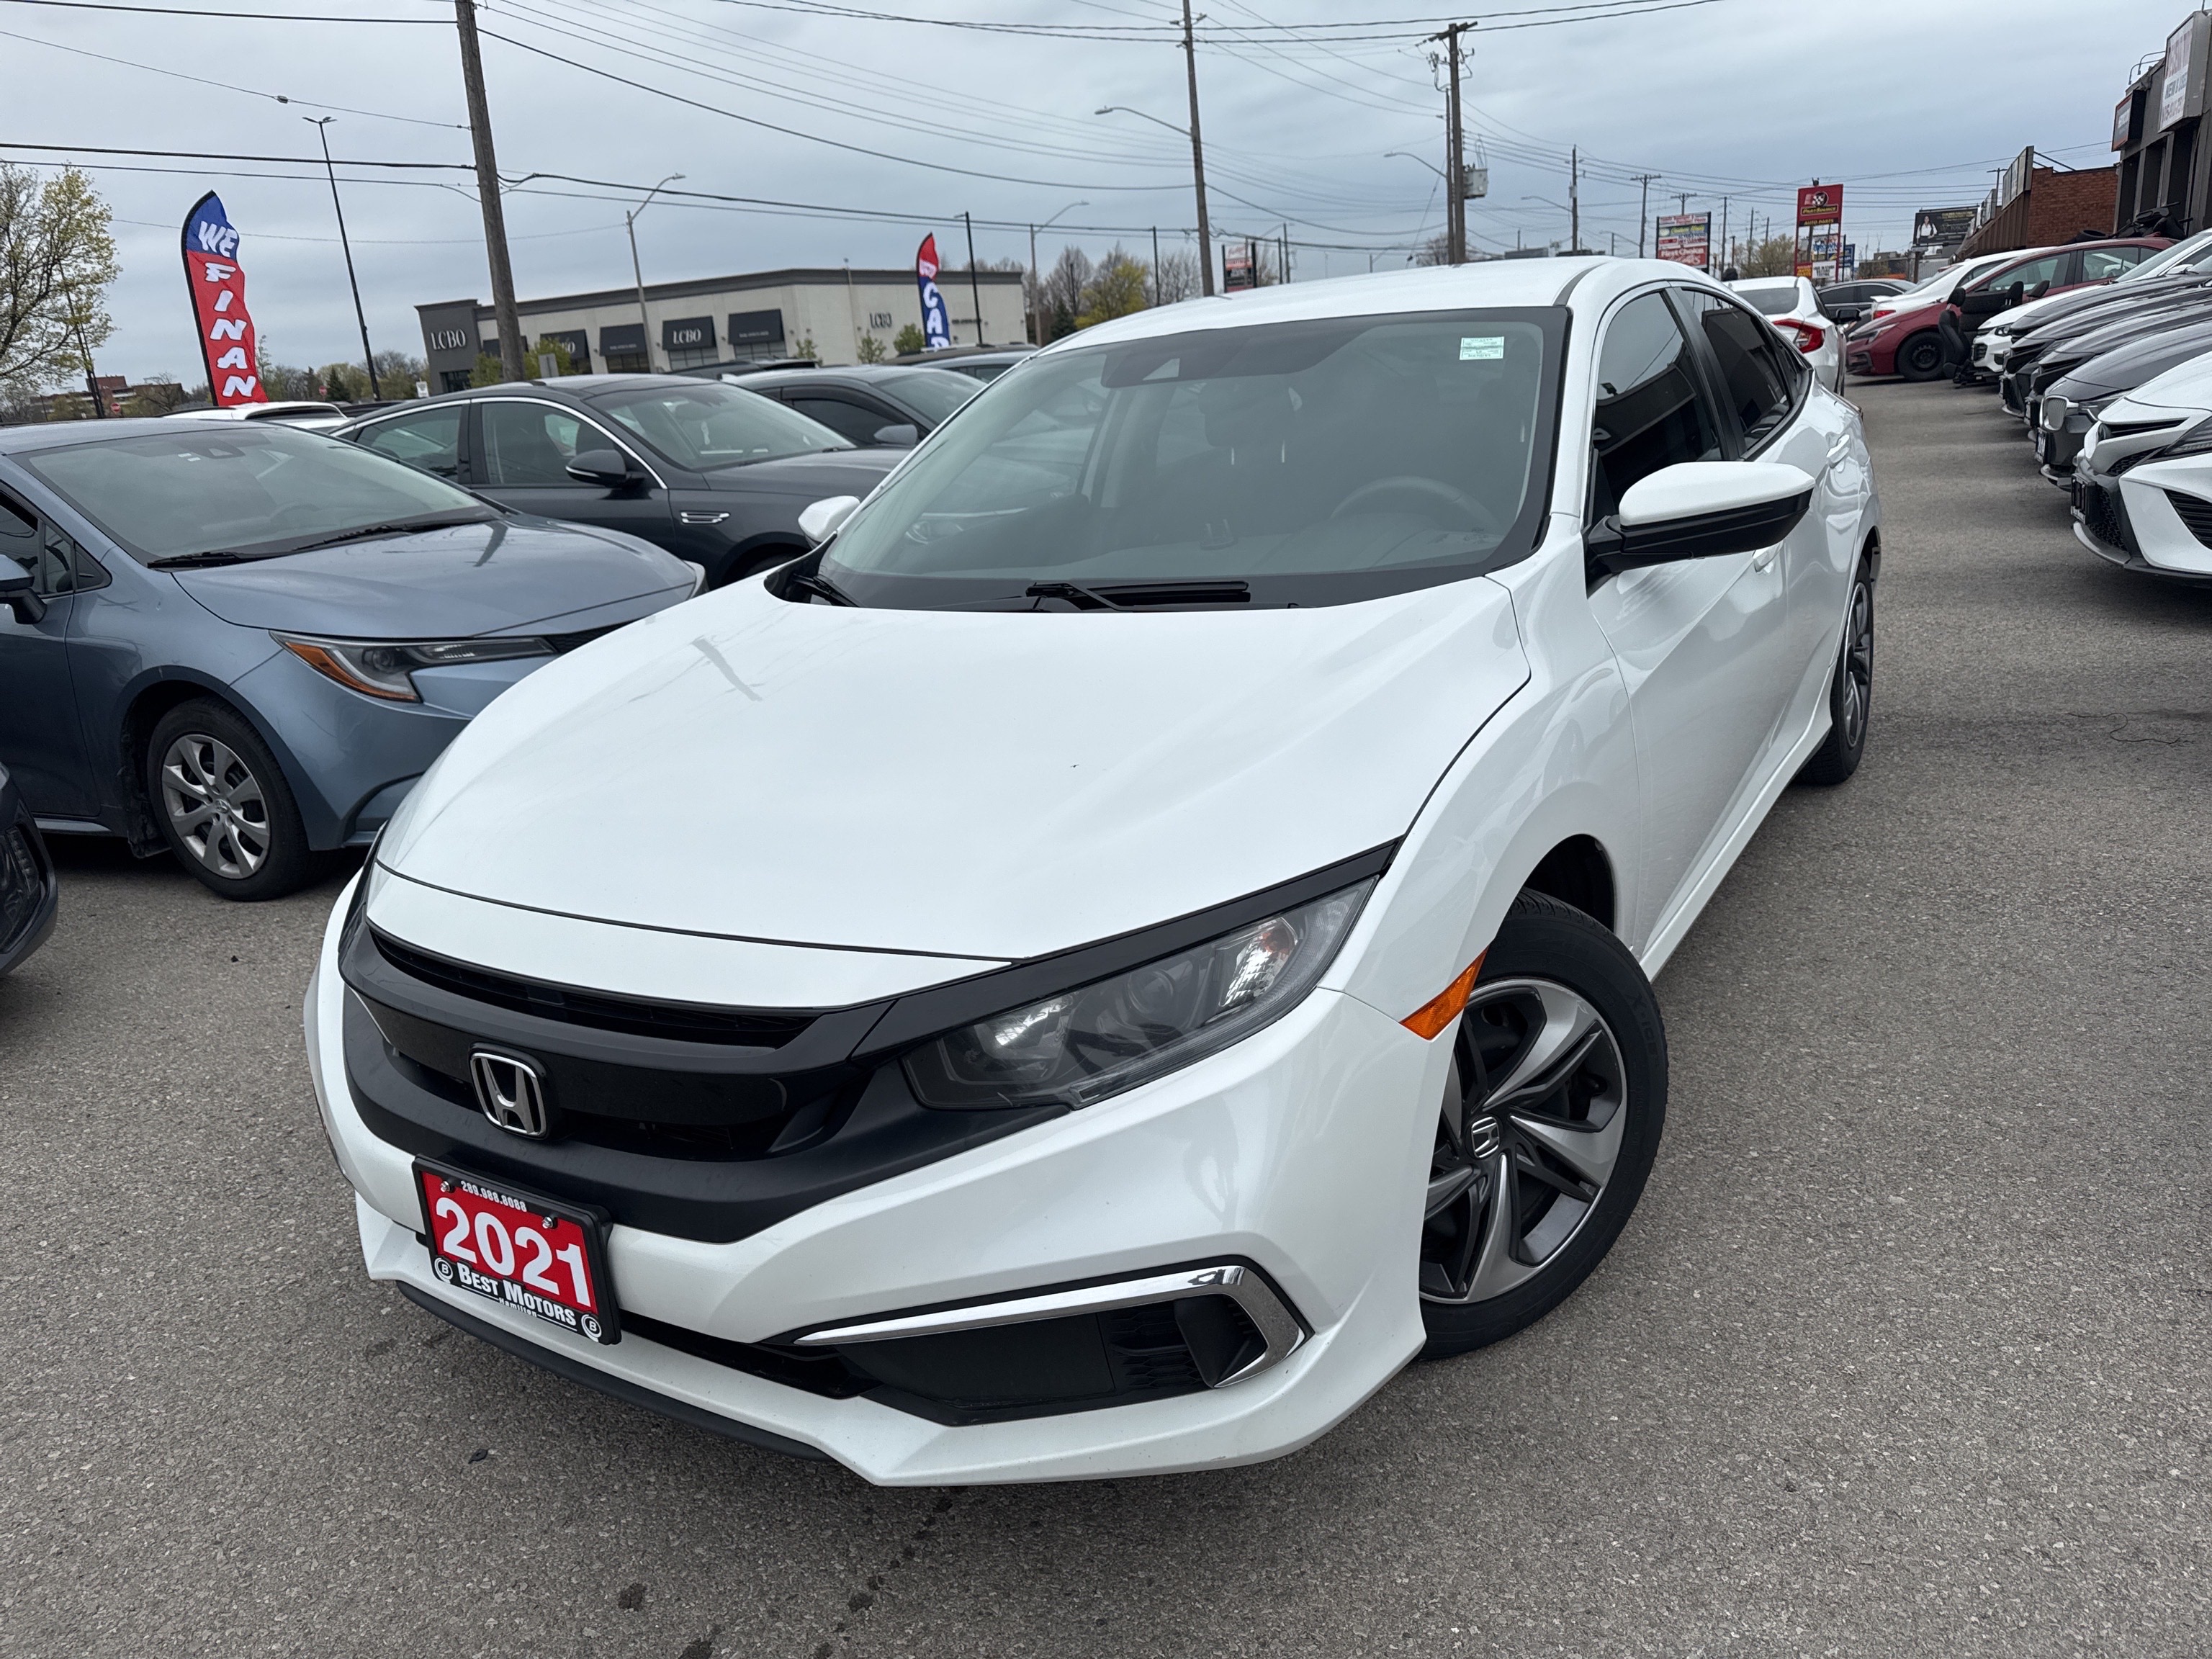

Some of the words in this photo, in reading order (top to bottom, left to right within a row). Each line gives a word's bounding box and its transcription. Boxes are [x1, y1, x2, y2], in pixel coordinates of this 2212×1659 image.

[198, 221, 238, 258] WE
[204, 262, 256, 397] FINAN
[431, 328, 466, 350] LCBO
[673, 328, 702, 345] LCBO
[460, 1180, 527, 1213] 289.988.8088
[436, 1197, 591, 1308] 2021
[499, 1297, 538, 1318] Hamilton
